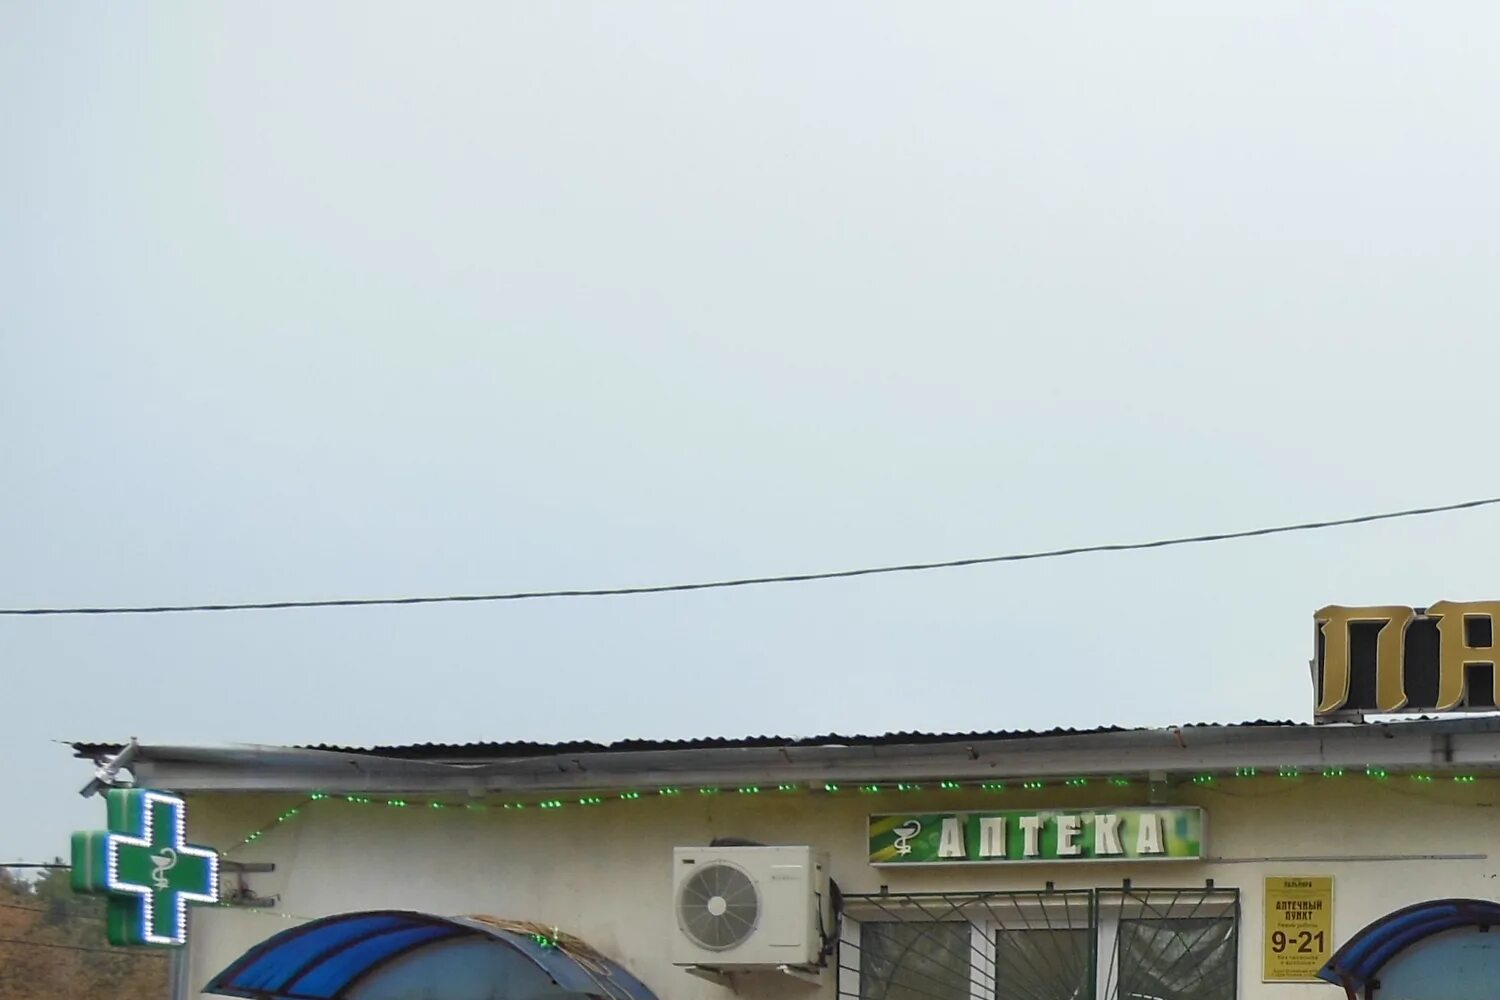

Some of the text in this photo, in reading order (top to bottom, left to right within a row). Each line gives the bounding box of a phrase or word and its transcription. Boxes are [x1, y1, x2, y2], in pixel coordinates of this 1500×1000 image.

[938, 813, 1165, 857] АПТЕКА
[1276, 900, 1322, 910] АПТЕЧНЫЙ
[1285, 911, 1313, 920] ПУНКТ
[1271, 931, 1324, 953] 9-21
